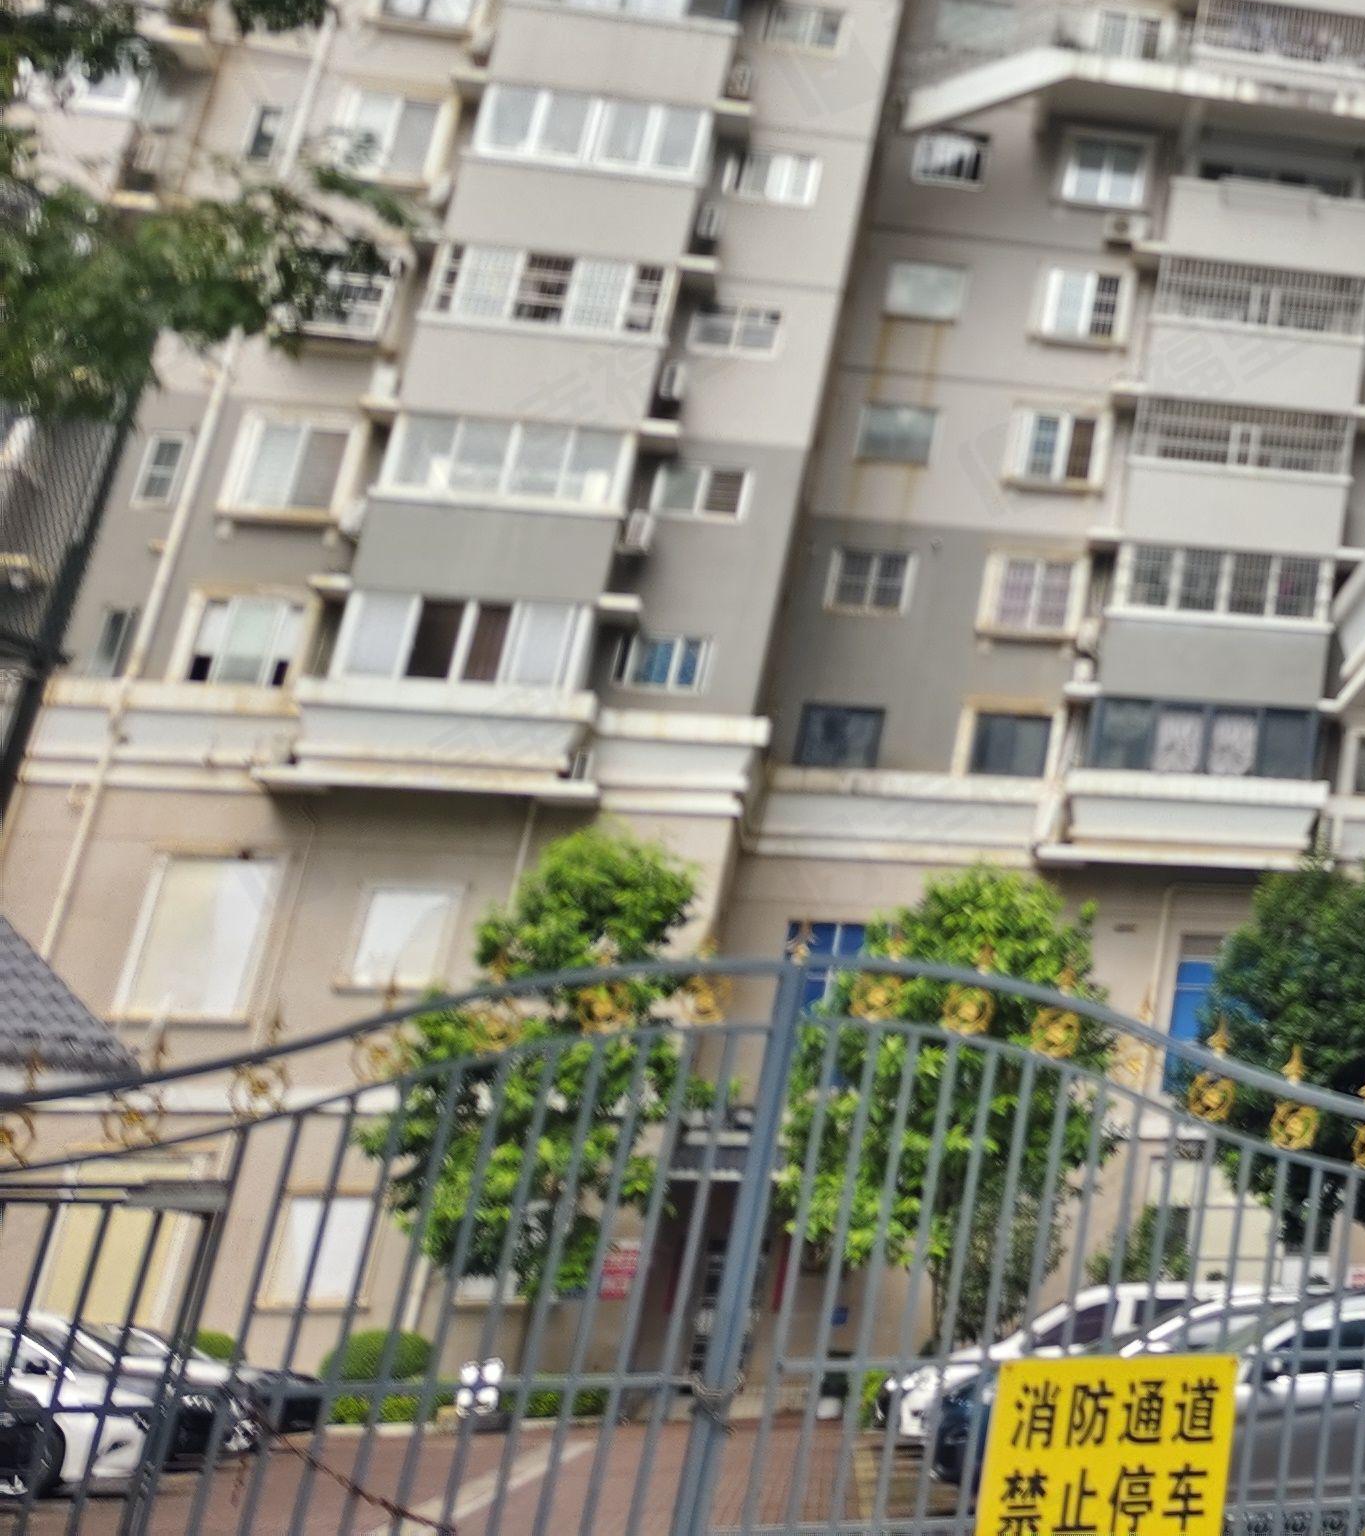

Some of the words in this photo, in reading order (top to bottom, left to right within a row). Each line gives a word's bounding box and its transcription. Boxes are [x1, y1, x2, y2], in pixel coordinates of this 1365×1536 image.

[1011, 1378, 1219, 1449] 消防通道
[997, 1463, 1208, 1536] 禁止停车
